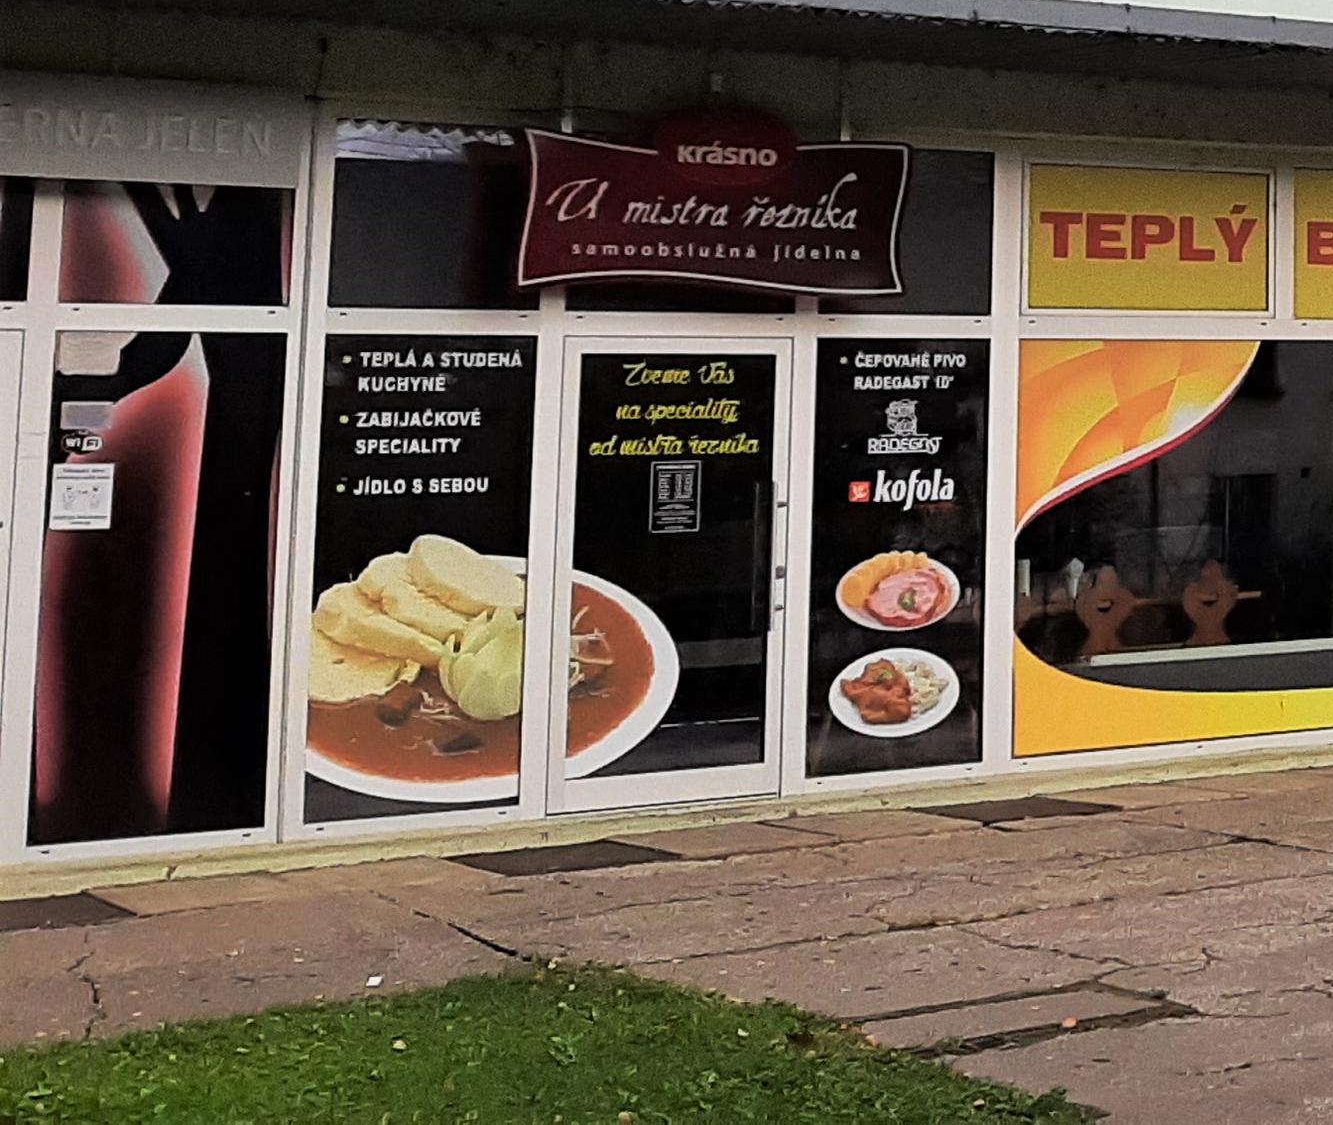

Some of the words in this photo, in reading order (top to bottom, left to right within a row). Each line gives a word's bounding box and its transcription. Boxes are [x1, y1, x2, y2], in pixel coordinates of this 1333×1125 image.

[545, 177, 609, 223] U
[622, 194, 728, 228] mistra
[741, 173, 858, 230] řezníka
[1040, 204, 1258, 263] TEPLÝ
[360, 349, 417, 368] TEPLÁ
[421, 352, 435, 368] A
[440, 349, 523, 368] STUDENÁ
[933, 353, 967, 368] PIVO
[853, 375, 930, 390] RADEGAST
[354, 438, 462, 456] SPECIALITY
[353, 475, 406, 495] JÍDLO
[412, 478, 423, 494] S
[428, 476, 489, 494] SEBOU
[873, 468, 956, 511] kofola
